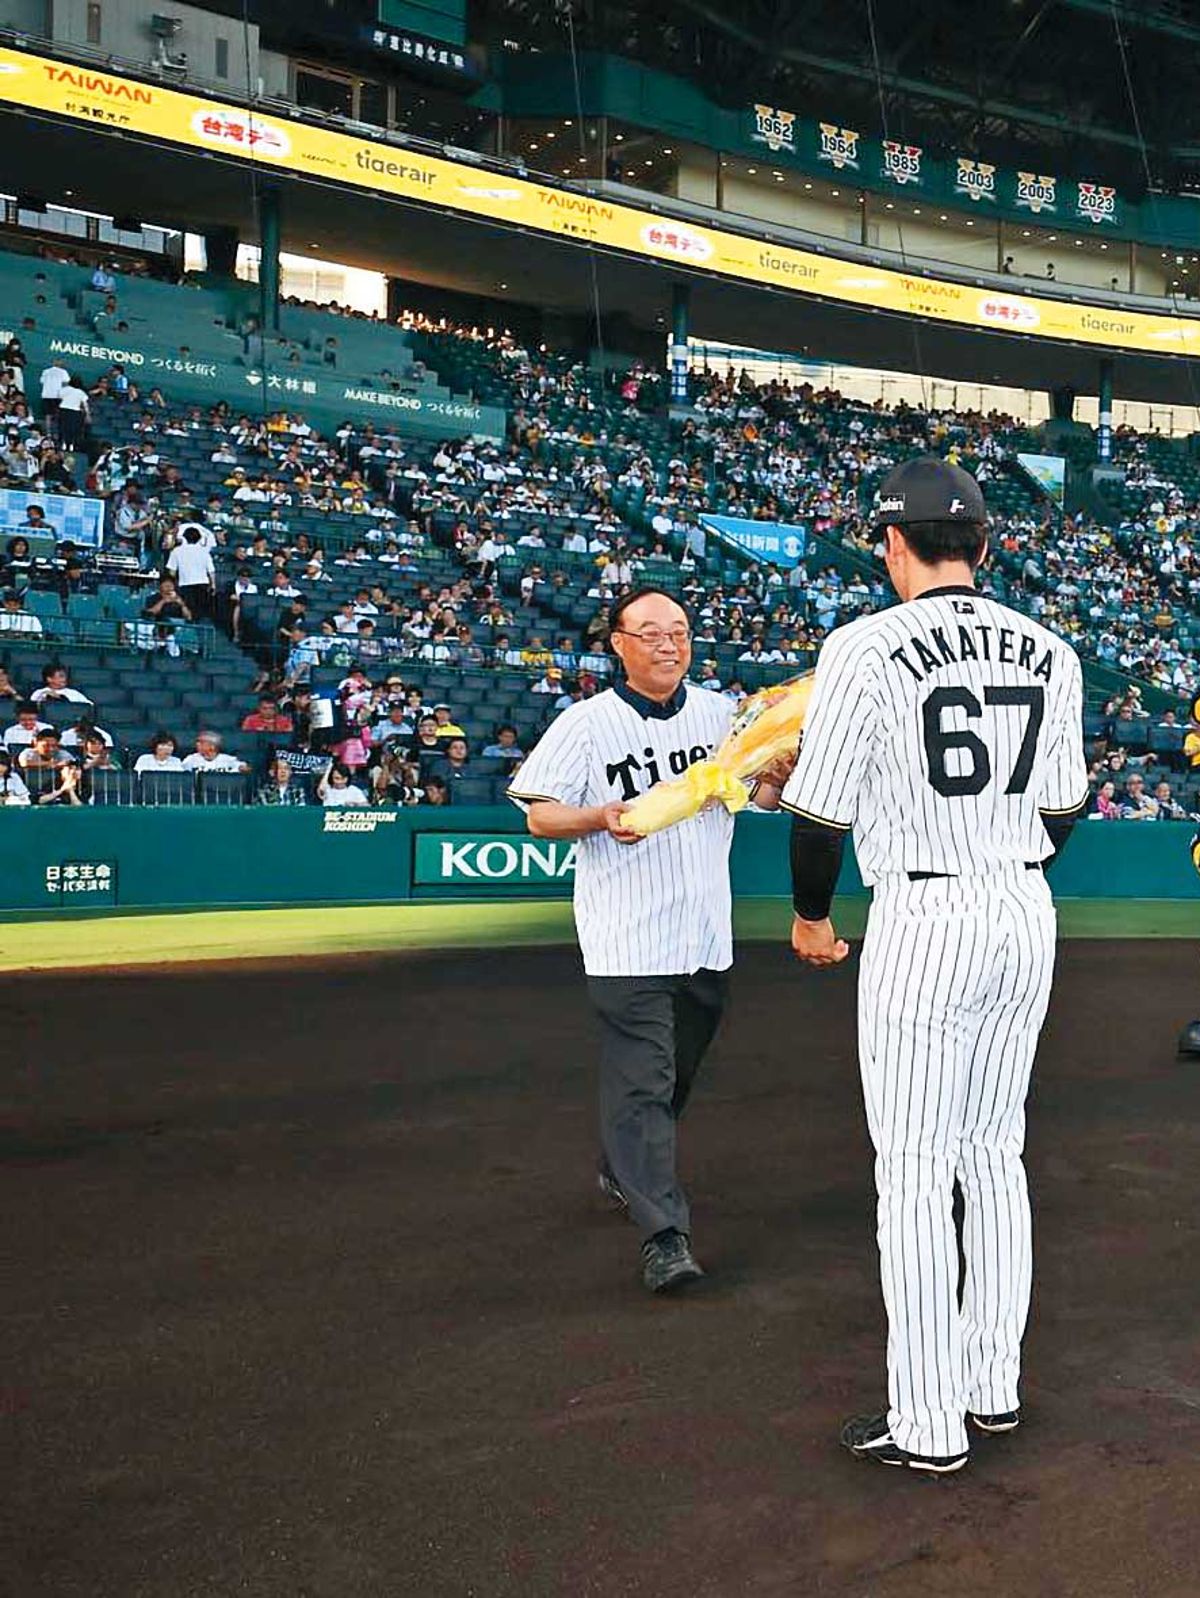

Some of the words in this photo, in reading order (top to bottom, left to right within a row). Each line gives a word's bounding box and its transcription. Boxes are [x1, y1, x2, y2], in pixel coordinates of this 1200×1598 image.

[43, 66, 152, 104] TAIWAN
[757, 115, 793, 140] 1962
[823, 134, 857, 158] 1964
[886, 151, 919, 173] 1985
[958, 168, 994, 190] 2003
[1019, 181, 1054, 202] 2005
[537, 191, 614, 220] TAIWAN
[1079, 192, 1114, 211] 2023
[50, 340, 89, 357] MAKE
[90, 346, 145, 366] BEYOND
[343, 388, 379, 403] MAKE
[377, 393, 422, 411] BEYOND
[890, 615, 1053, 683] TAKATERA
[922, 686, 1045, 798] 67
[606, 744, 714, 802] Tige
[440, 841, 577, 877] KONA
[46, 864, 111, 880] 日本生命
